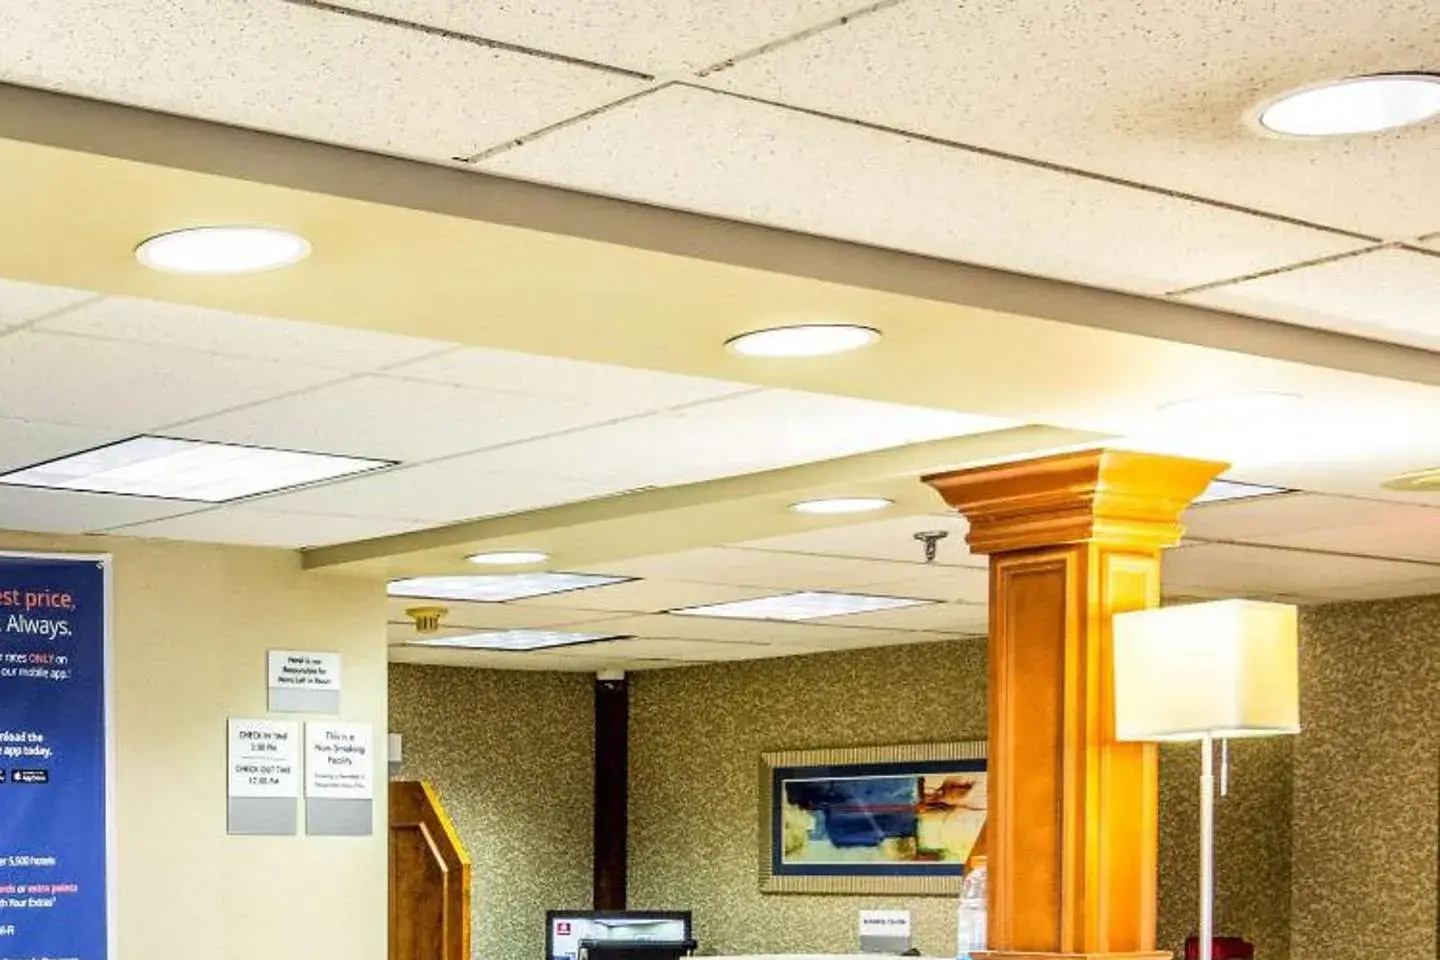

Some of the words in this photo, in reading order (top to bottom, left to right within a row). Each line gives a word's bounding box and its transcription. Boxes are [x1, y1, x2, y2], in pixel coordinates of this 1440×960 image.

[6, 614, 72, 640] Always.
[28, 653, 54, 664] ONLY
[56, 656, 68, 664] on
[1, 668, 17, 677] our
[19, 667, 48, 678] mobile
[28, 733, 44, 742] the
[4, 746, 22, 757] app
[23, 746, 53, 758] today.
[31, 856, 56, 867] hotels
[17, 885, 26, 893] or
[9, 898, 28, 907] Your
